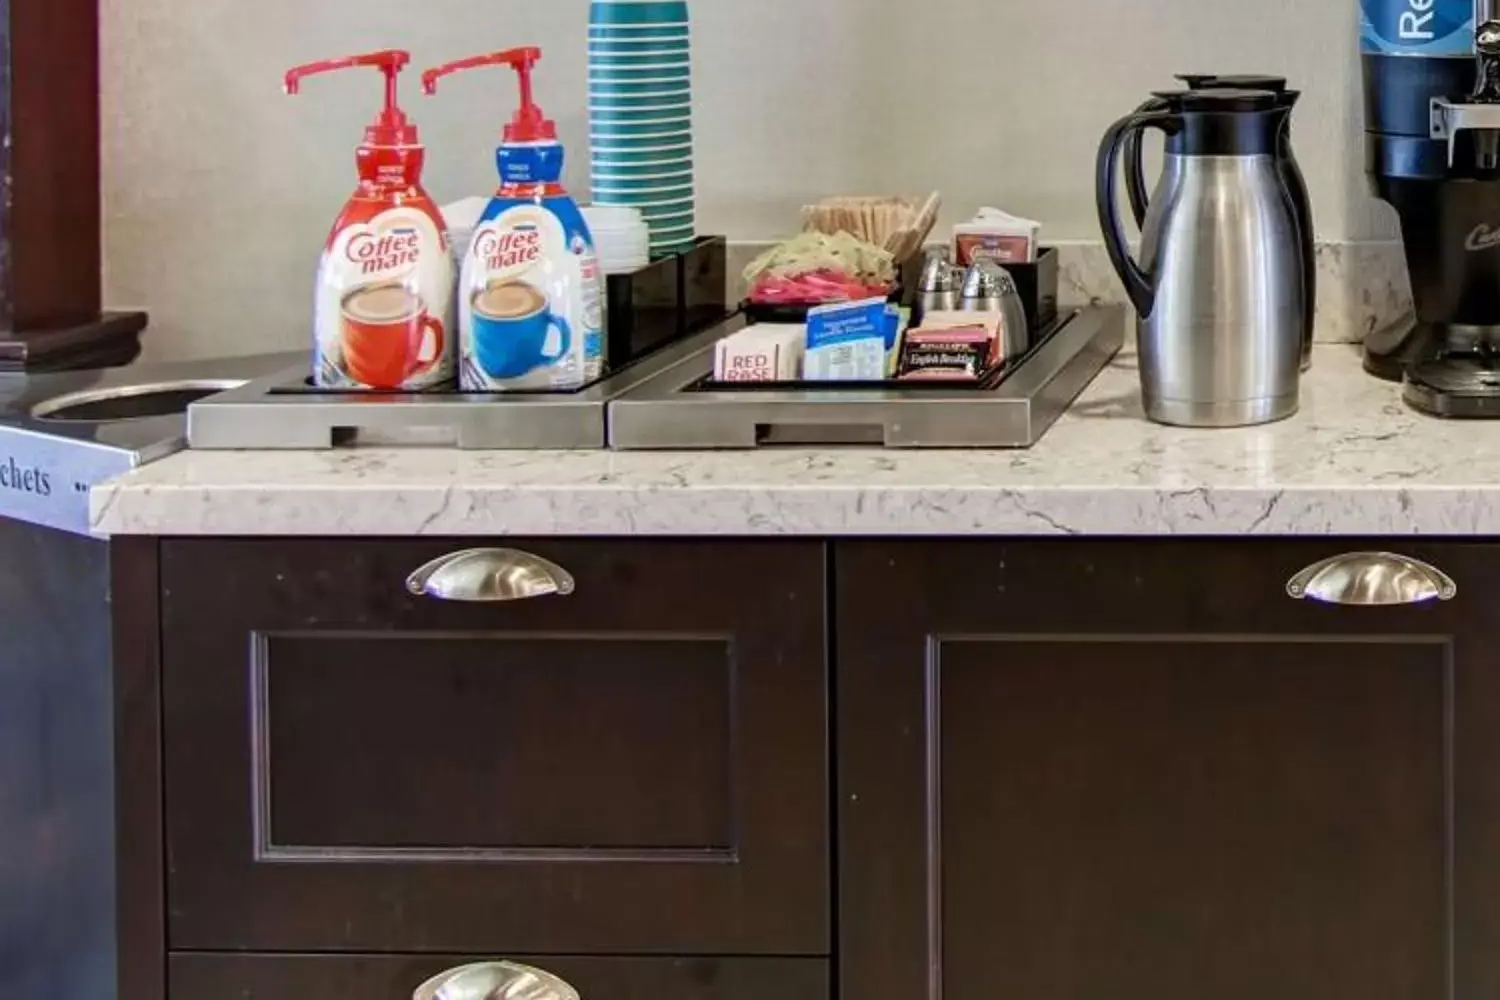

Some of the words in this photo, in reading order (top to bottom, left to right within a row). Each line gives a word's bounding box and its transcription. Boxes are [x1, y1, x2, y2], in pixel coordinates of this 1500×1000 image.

[346, 231, 420, 263] Coffee
[473, 228, 540, 258] Coffee
[362, 249, 420, 275] mate
[485, 246, 540, 271] mate
[733, 354, 767, 369] RED
